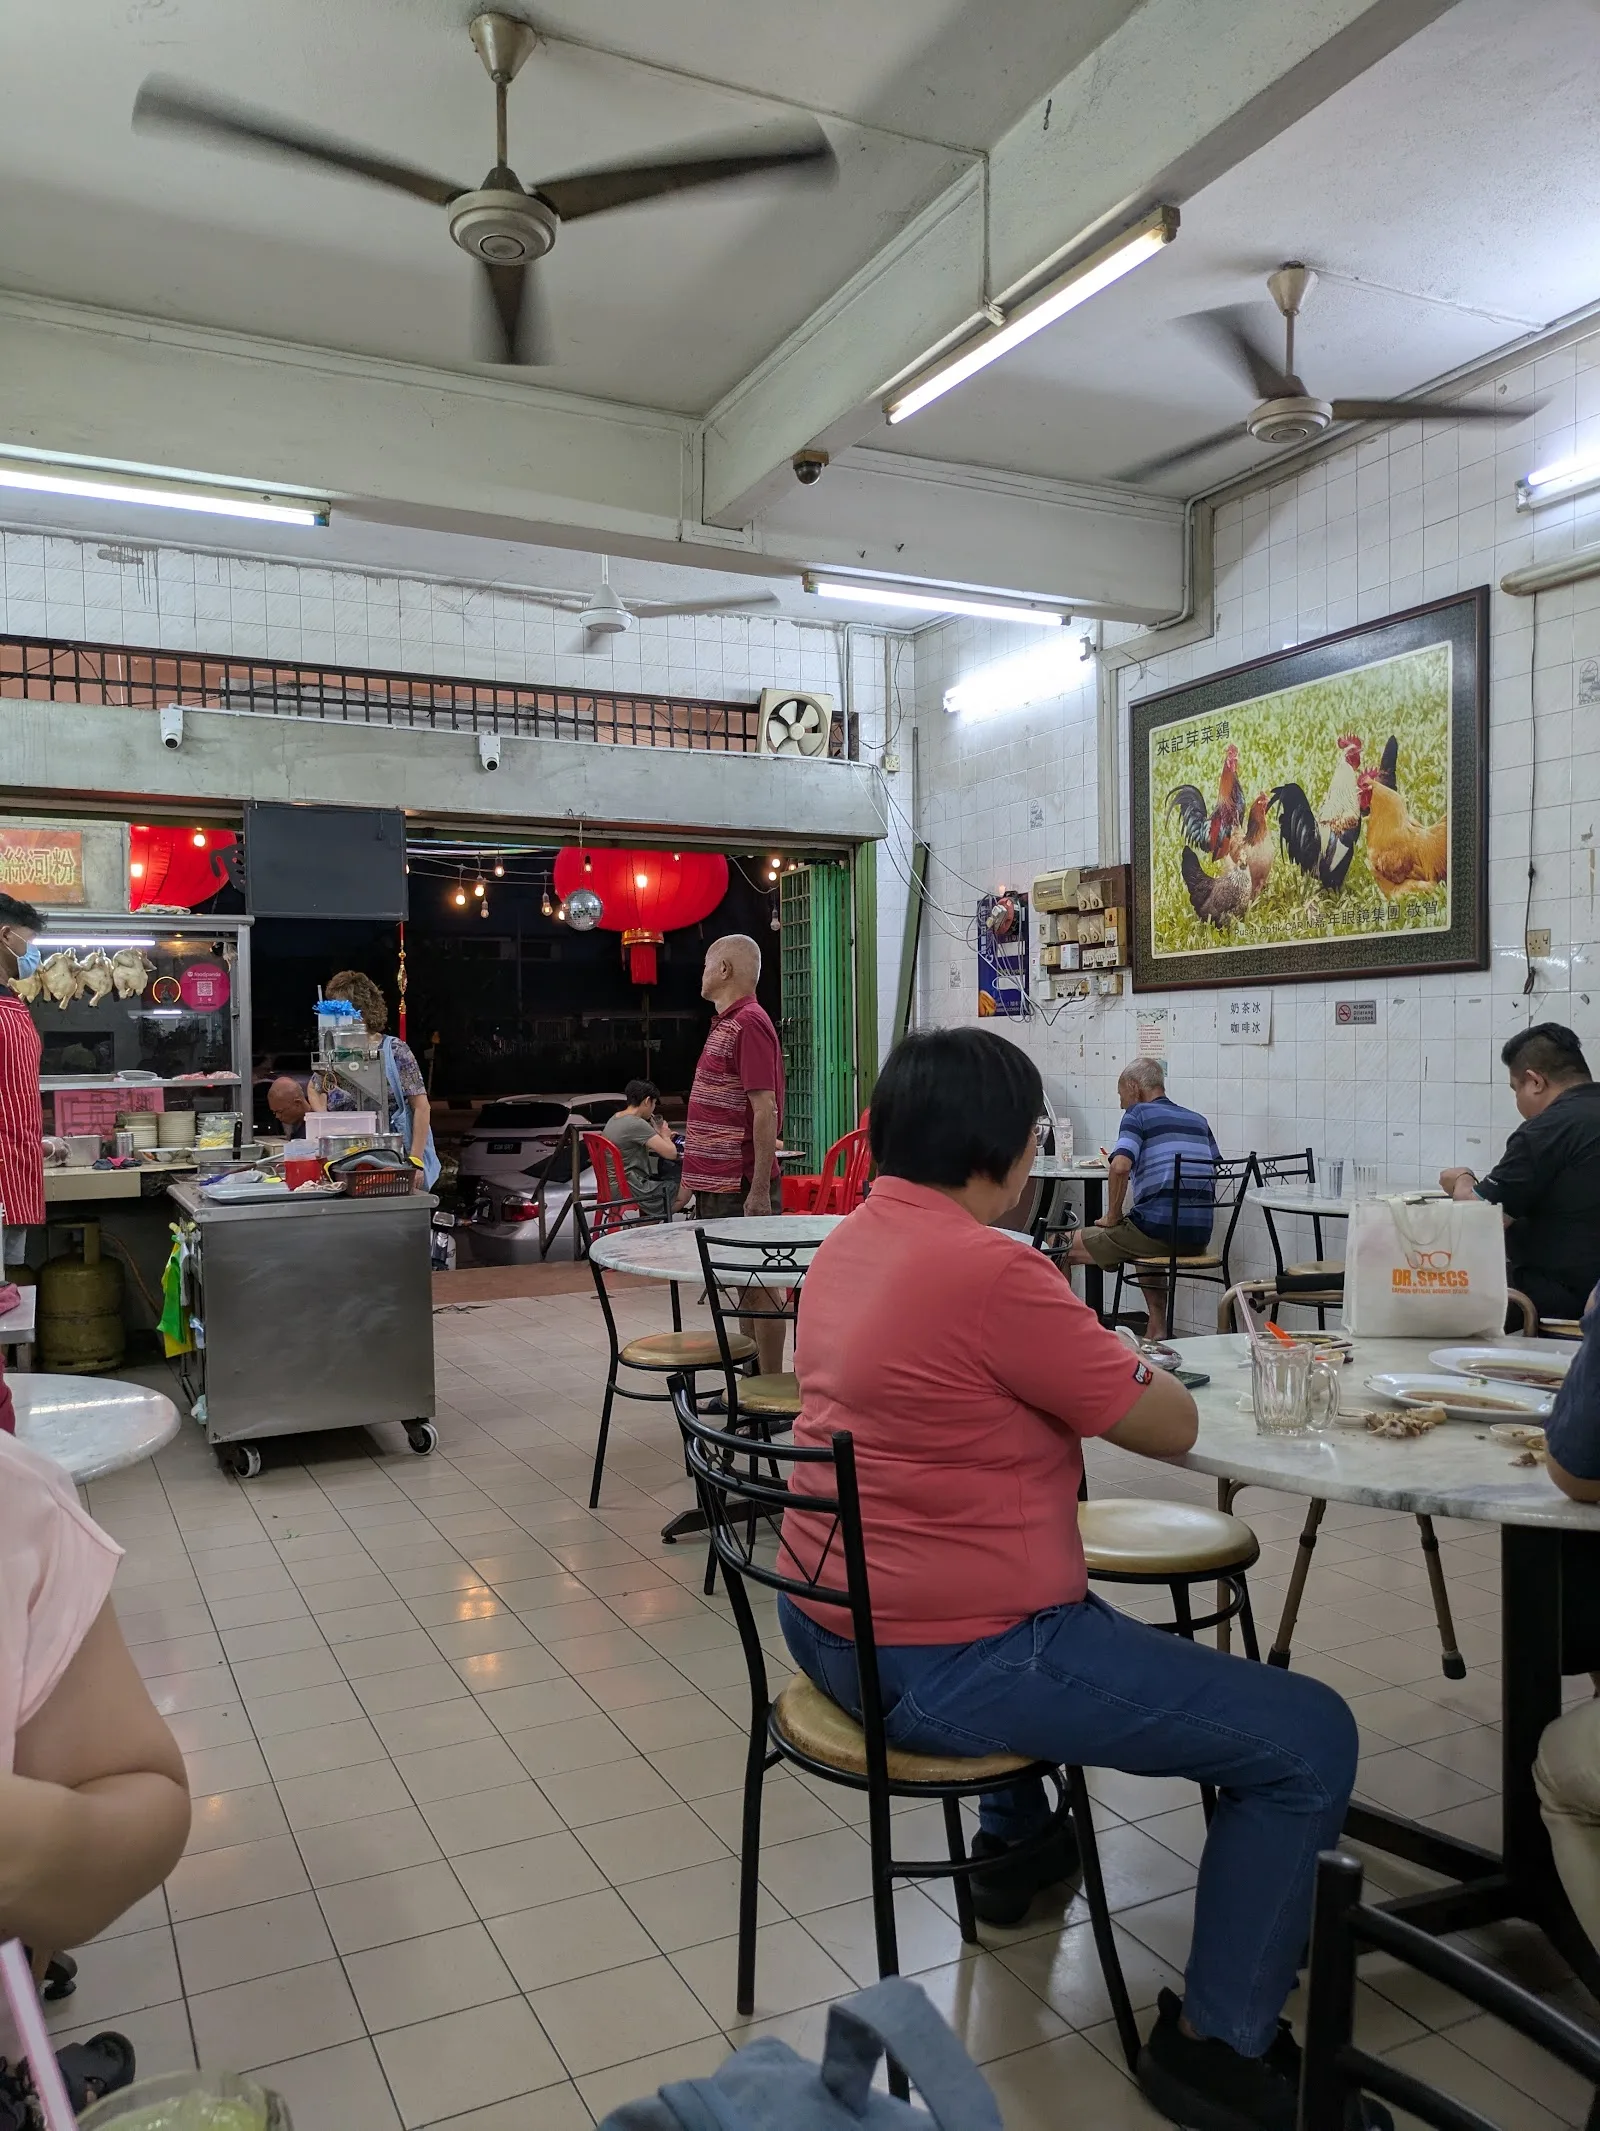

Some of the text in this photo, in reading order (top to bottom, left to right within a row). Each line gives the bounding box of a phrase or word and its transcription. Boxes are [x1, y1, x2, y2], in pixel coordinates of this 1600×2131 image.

[0, 846, 76, 885] 絲河粉
[1314, 900, 1438, 928] 嘉年眼鏡集團 敬賀
[1235, 926, 1257, 936] Pusat
[1260, 923, 1282, 935] Optik
[1230, 1002, 1261, 1014] 奶茶冰
